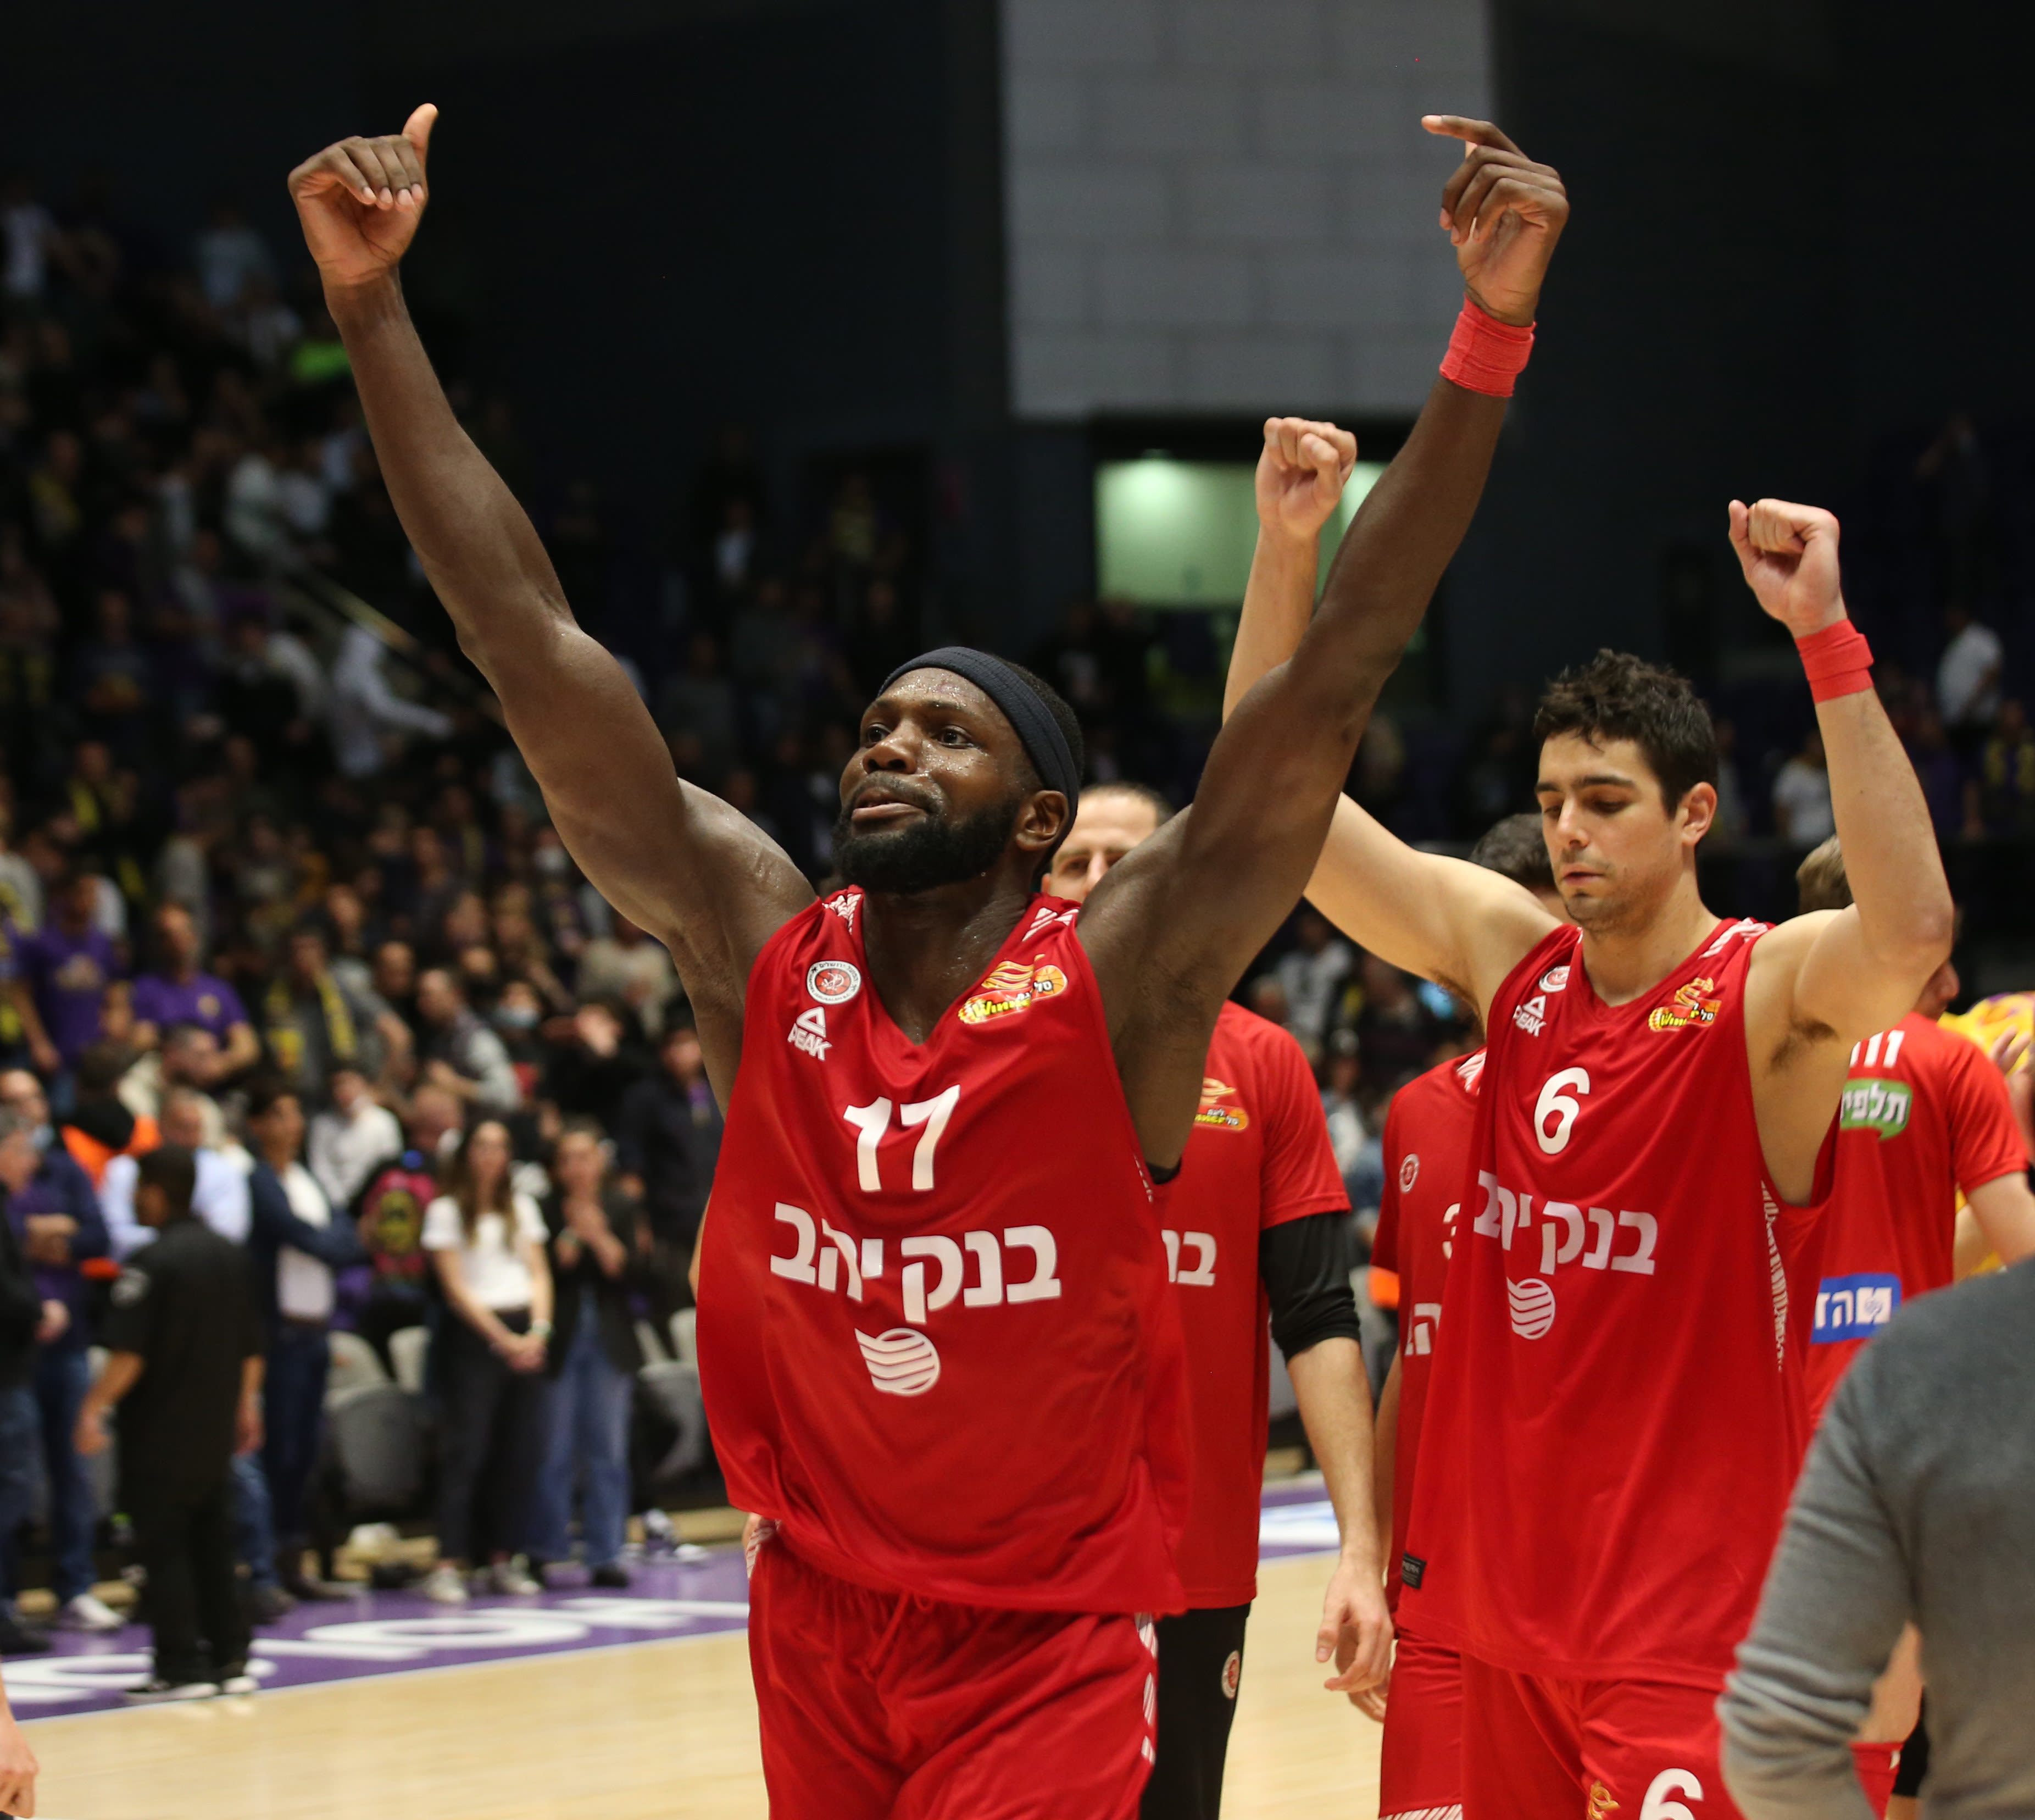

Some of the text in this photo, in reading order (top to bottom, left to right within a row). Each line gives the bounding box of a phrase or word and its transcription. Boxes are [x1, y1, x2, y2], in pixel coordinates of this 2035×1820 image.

[787, 1023, 832, 1061] PEAK
[1513, 1005, 1547, 1037] PEAK
[843, 1084, 960, 1191] 17
[1534, 1067, 1590, 1155] 6
[770, 1201, 1061, 1325] בנק יהב
[1539, 1201, 1658, 1275] בנק
